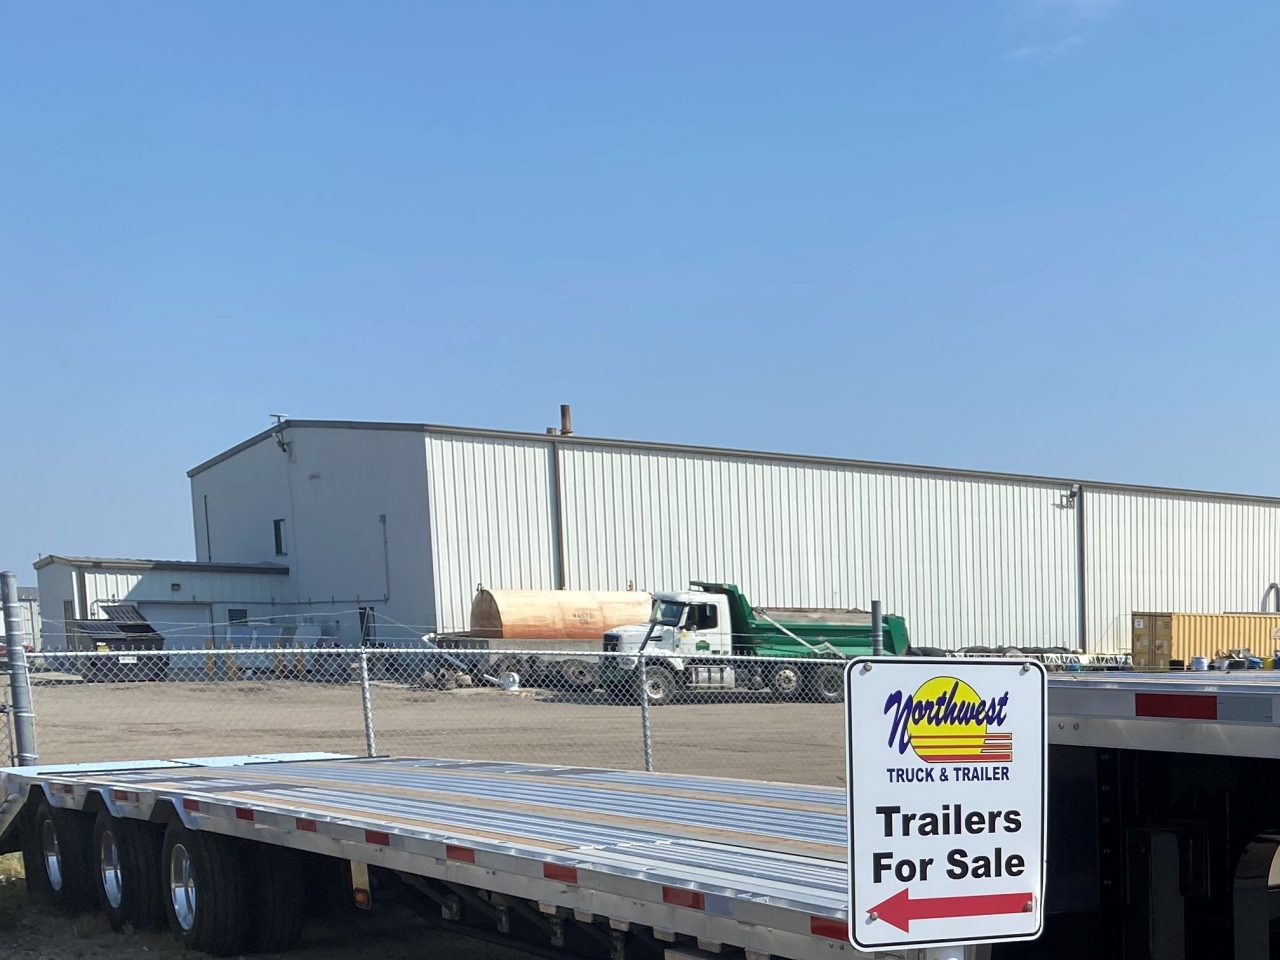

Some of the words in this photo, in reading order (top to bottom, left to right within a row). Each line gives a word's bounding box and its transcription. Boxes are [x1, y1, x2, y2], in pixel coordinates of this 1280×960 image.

[884, 681, 1009, 755] Northwest
[887, 768, 935, 783] TRUCK
[940, 767, 949, 782] &
[953, 766, 1009, 782] TRAILER
[876, 804, 1022, 837] Trailers
[873, 852, 934, 883] For
[946, 847, 1025, 880] Sale
